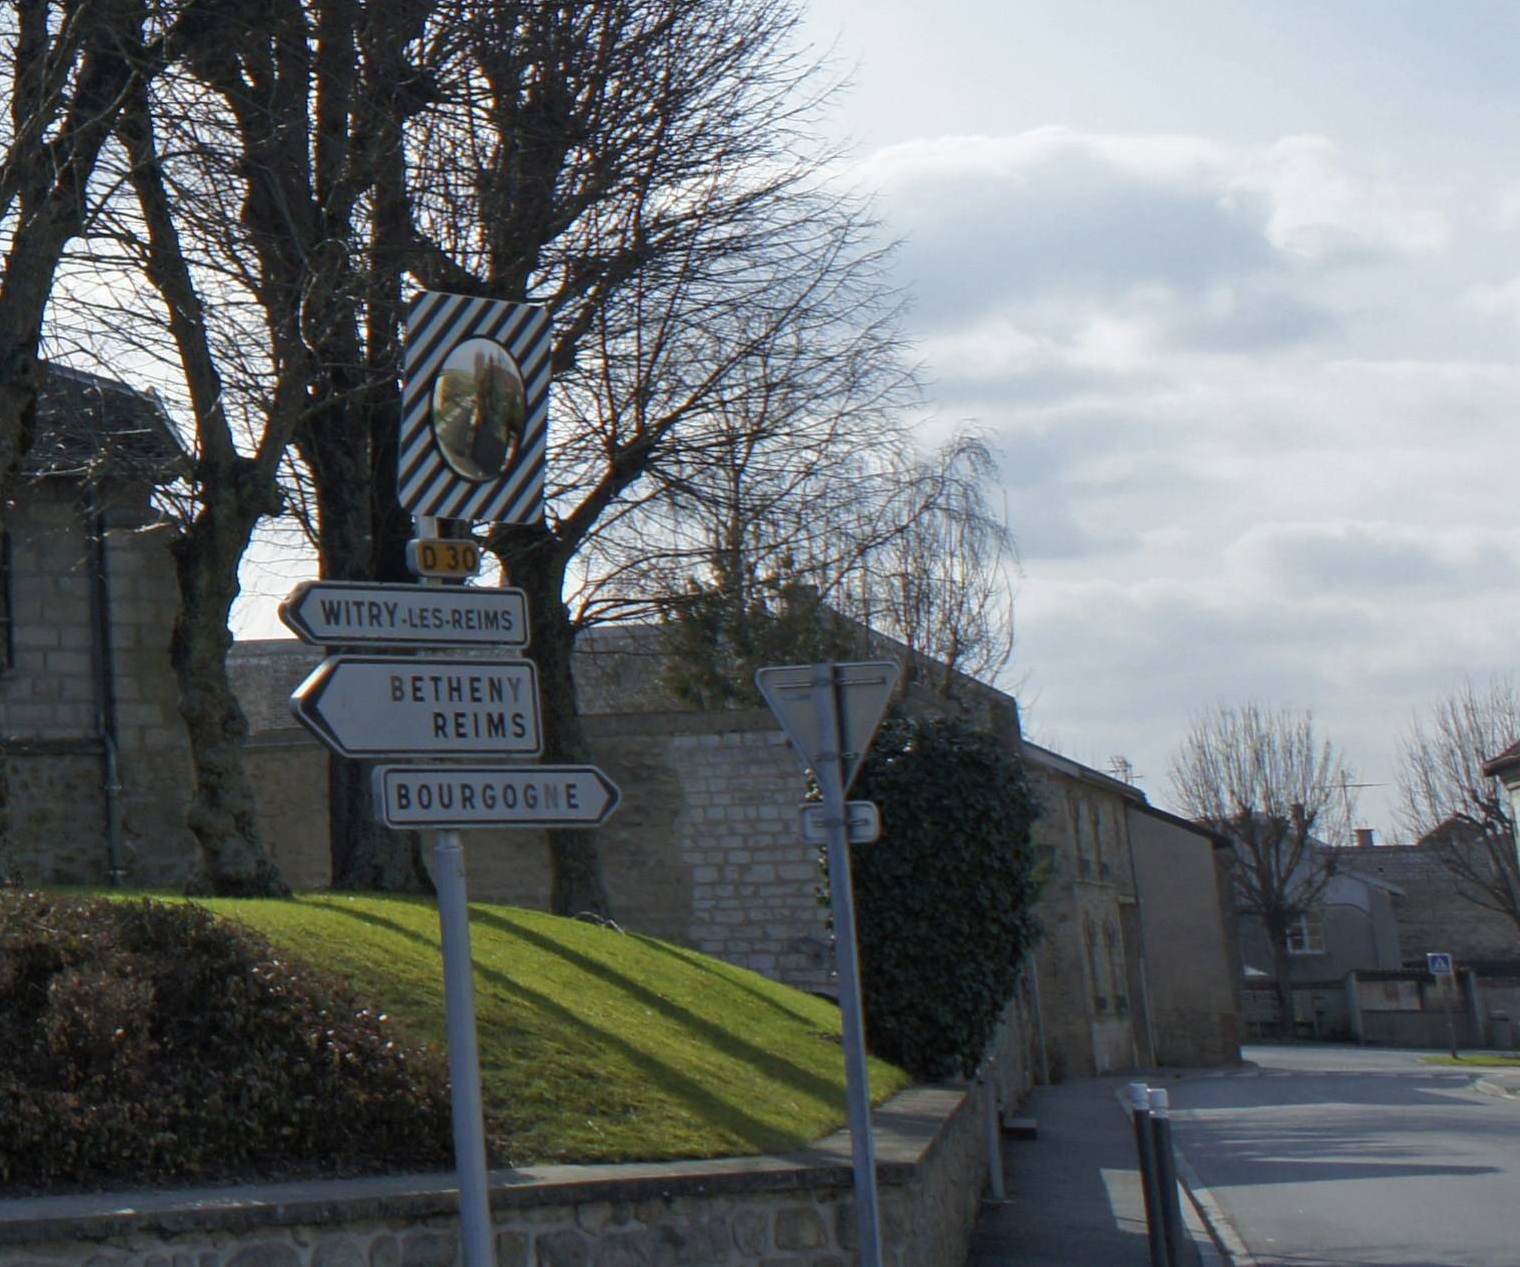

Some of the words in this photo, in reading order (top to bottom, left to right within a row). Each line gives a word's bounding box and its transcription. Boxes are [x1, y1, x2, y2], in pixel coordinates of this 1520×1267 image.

[422, 546, 438, 571] D
[447, 546, 478, 570] 30
[390, 675, 524, 704] BETHENY
[433, 711, 527, 739] REIMS
[396, 783, 580, 811] BOURGOGNE
